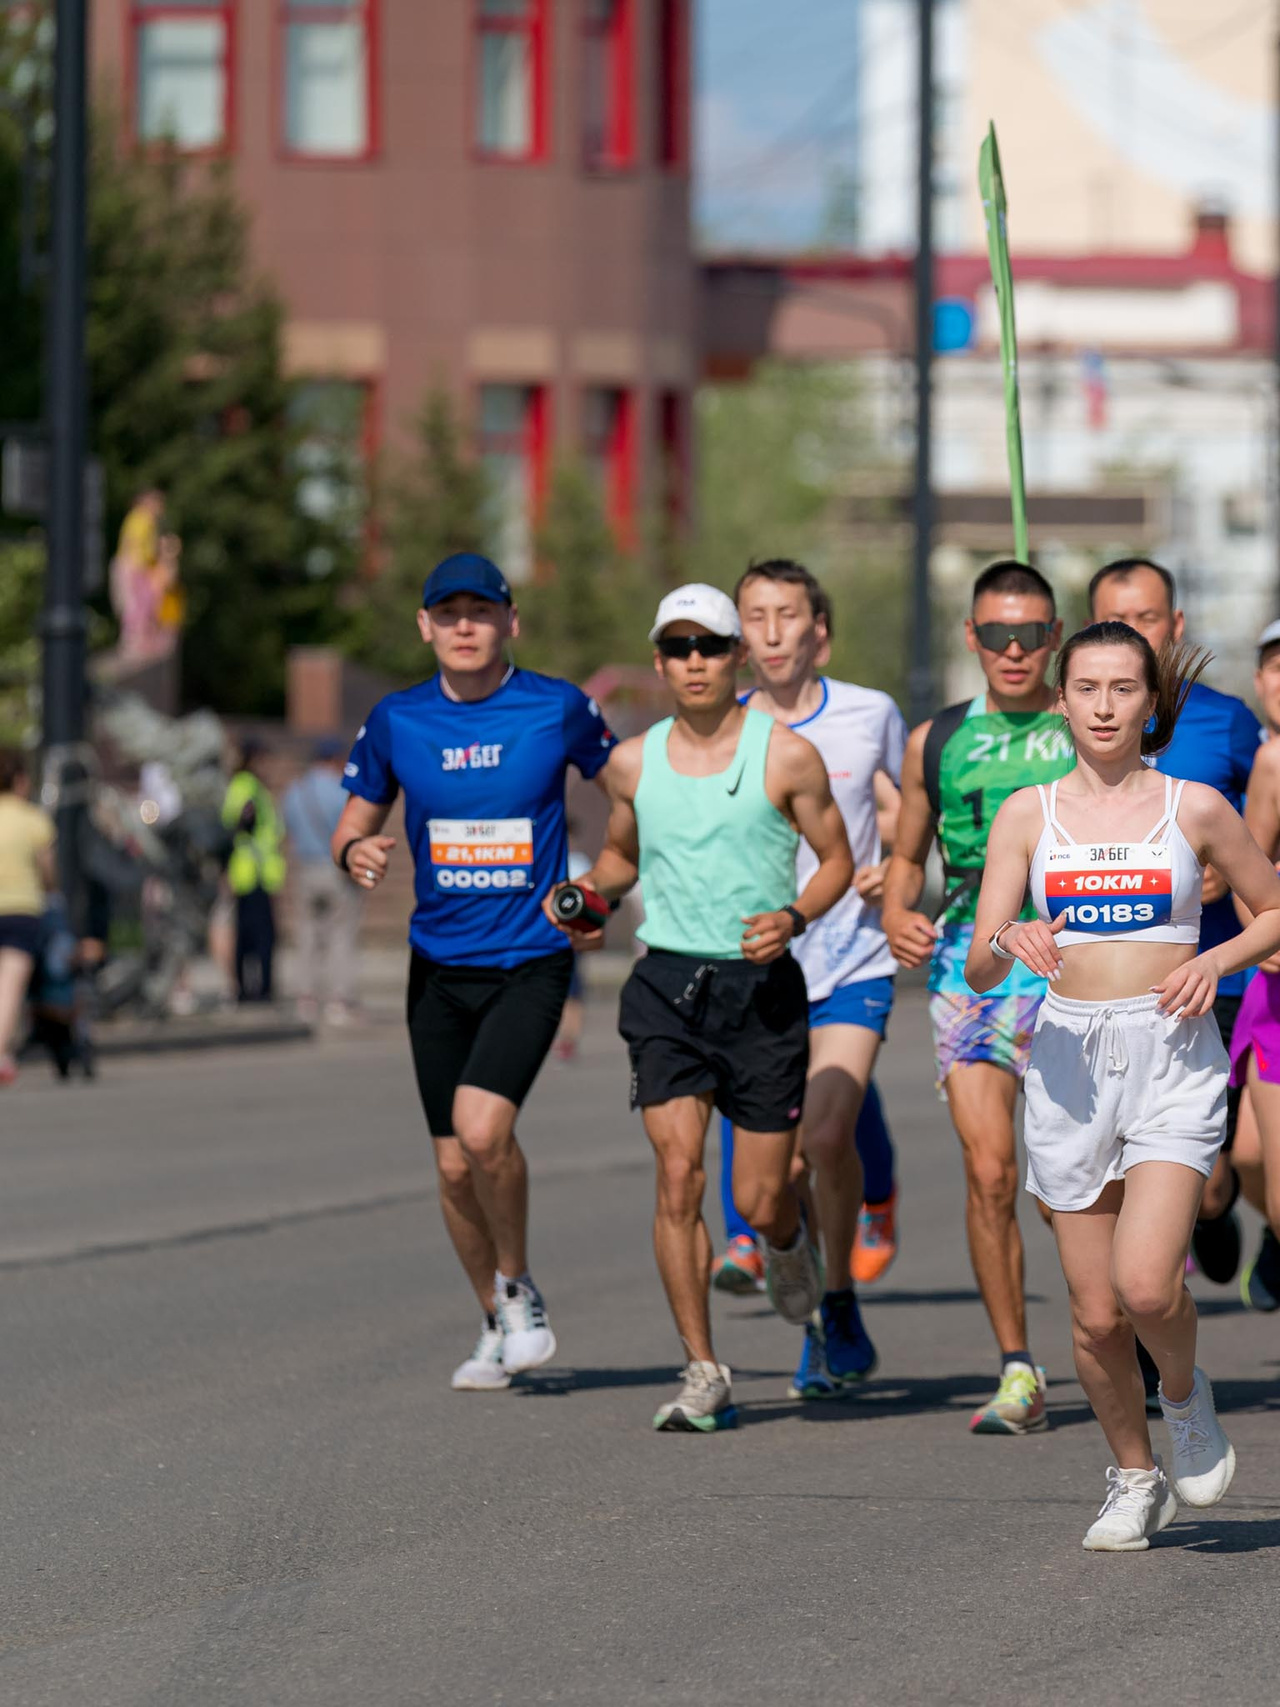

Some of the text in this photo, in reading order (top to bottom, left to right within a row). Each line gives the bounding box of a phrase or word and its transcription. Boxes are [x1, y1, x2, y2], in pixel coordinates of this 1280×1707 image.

[967, 732, 1012, 761] 21
[1074, 875, 1143, 890] 10KM
[1064, 903, 1154, 924] 10183
